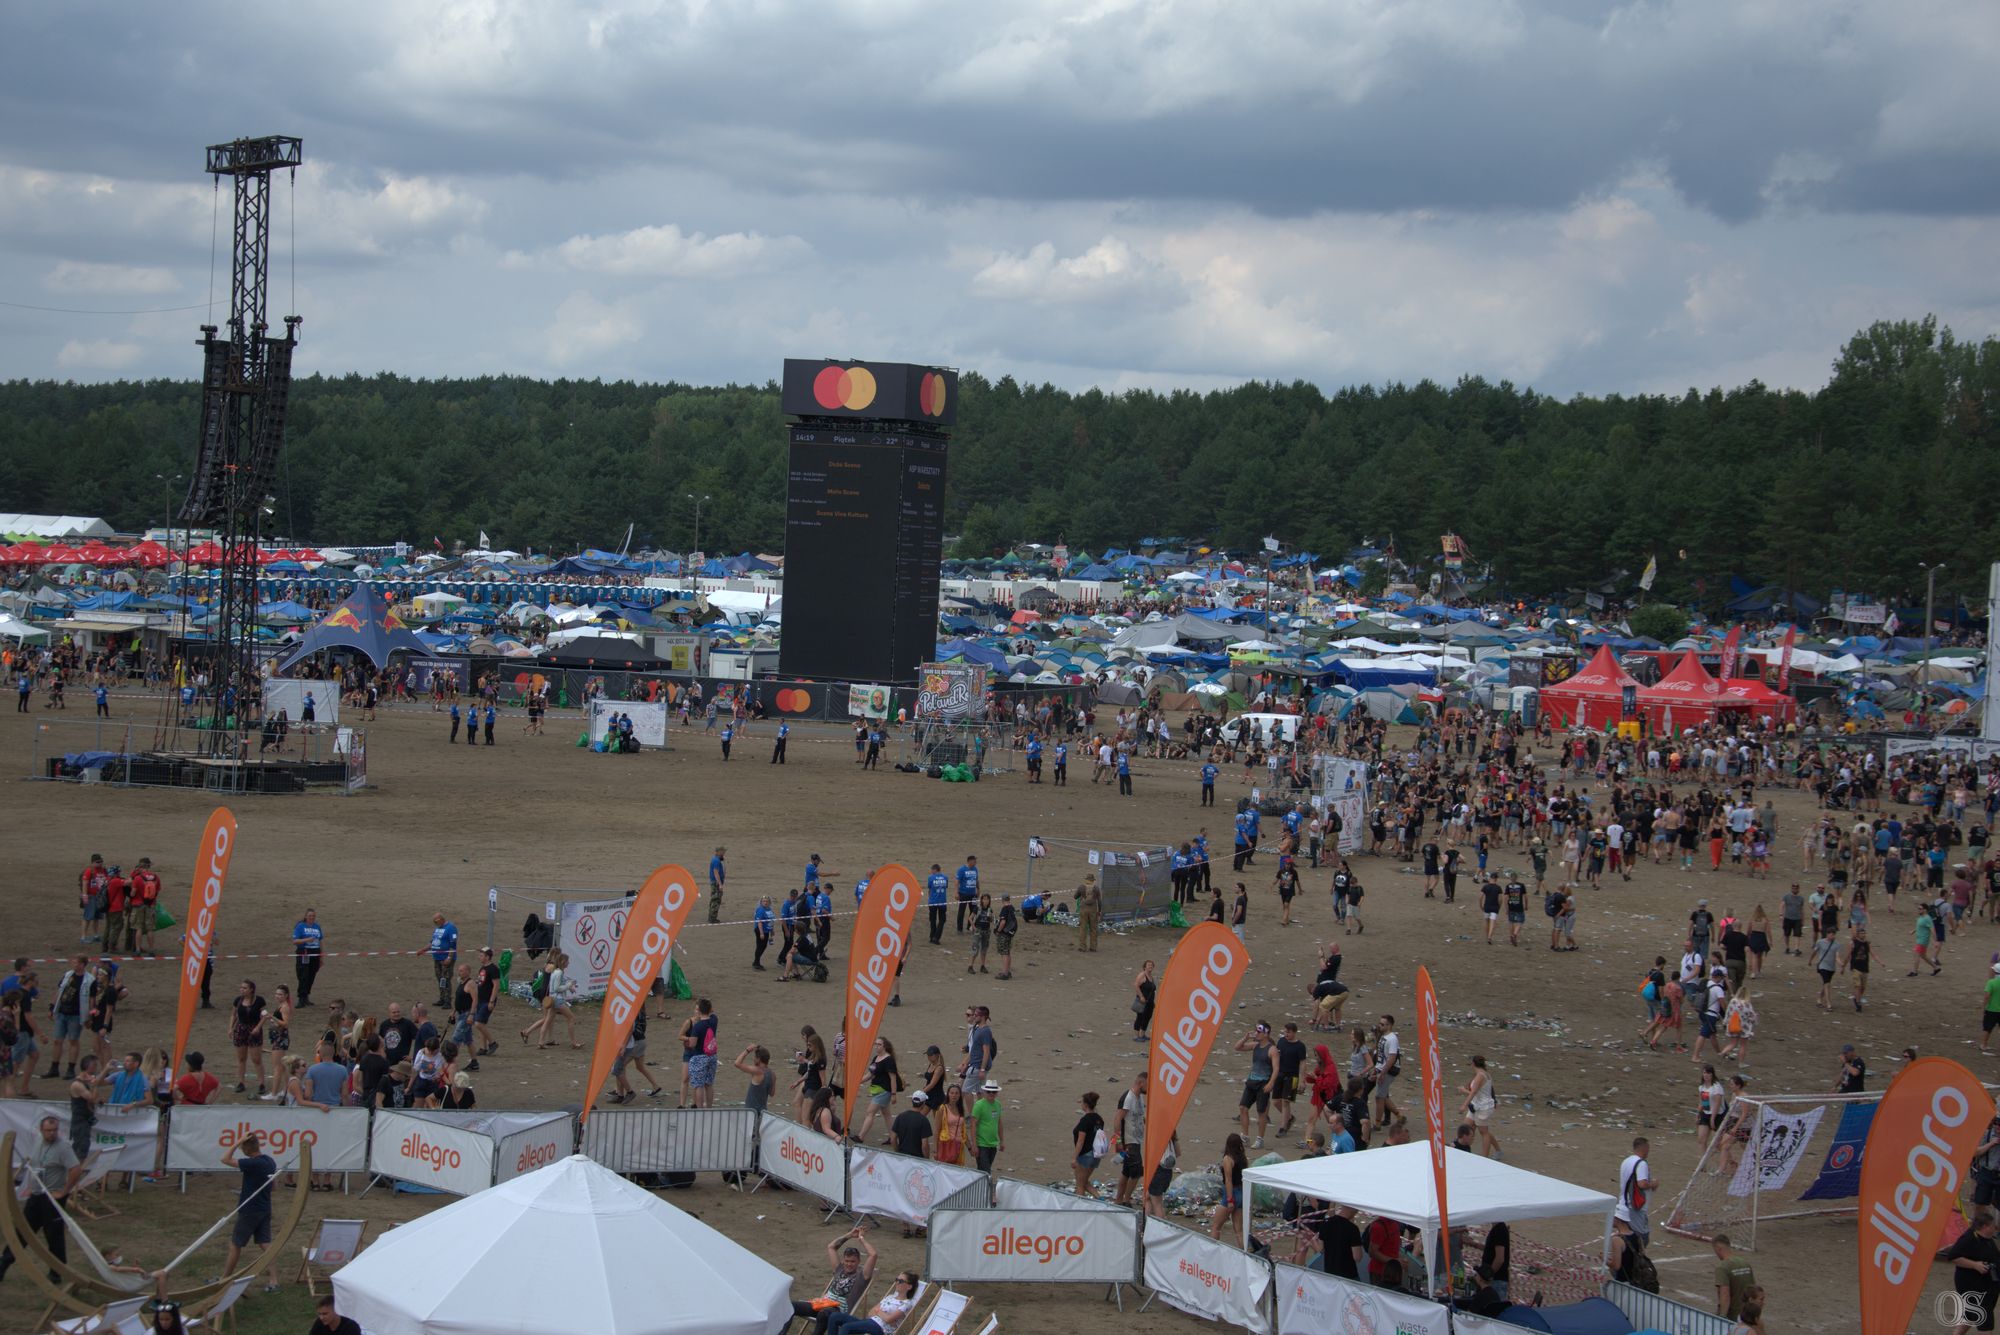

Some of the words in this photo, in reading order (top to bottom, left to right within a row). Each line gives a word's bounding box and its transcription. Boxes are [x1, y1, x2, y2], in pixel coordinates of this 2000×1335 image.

[188, 827, 228, 987] allegro
[609, 882, 685, 1026] allegro
[853, 882, 910, 1030] allegro
[1158, 942, 1233, 1096] allegro
[96, 1132, 126, 1144] less
[401, 1134, 461, 1171] allegro
[780, 1137, 825, 1174] allegro
[516, 1142, 556, 1172] allegro
[1870, 1086, 1969, 1286] allegro
[982, 1228, 1085, 1264] allegro
[1398, 1320, 1428, 1335] waste
